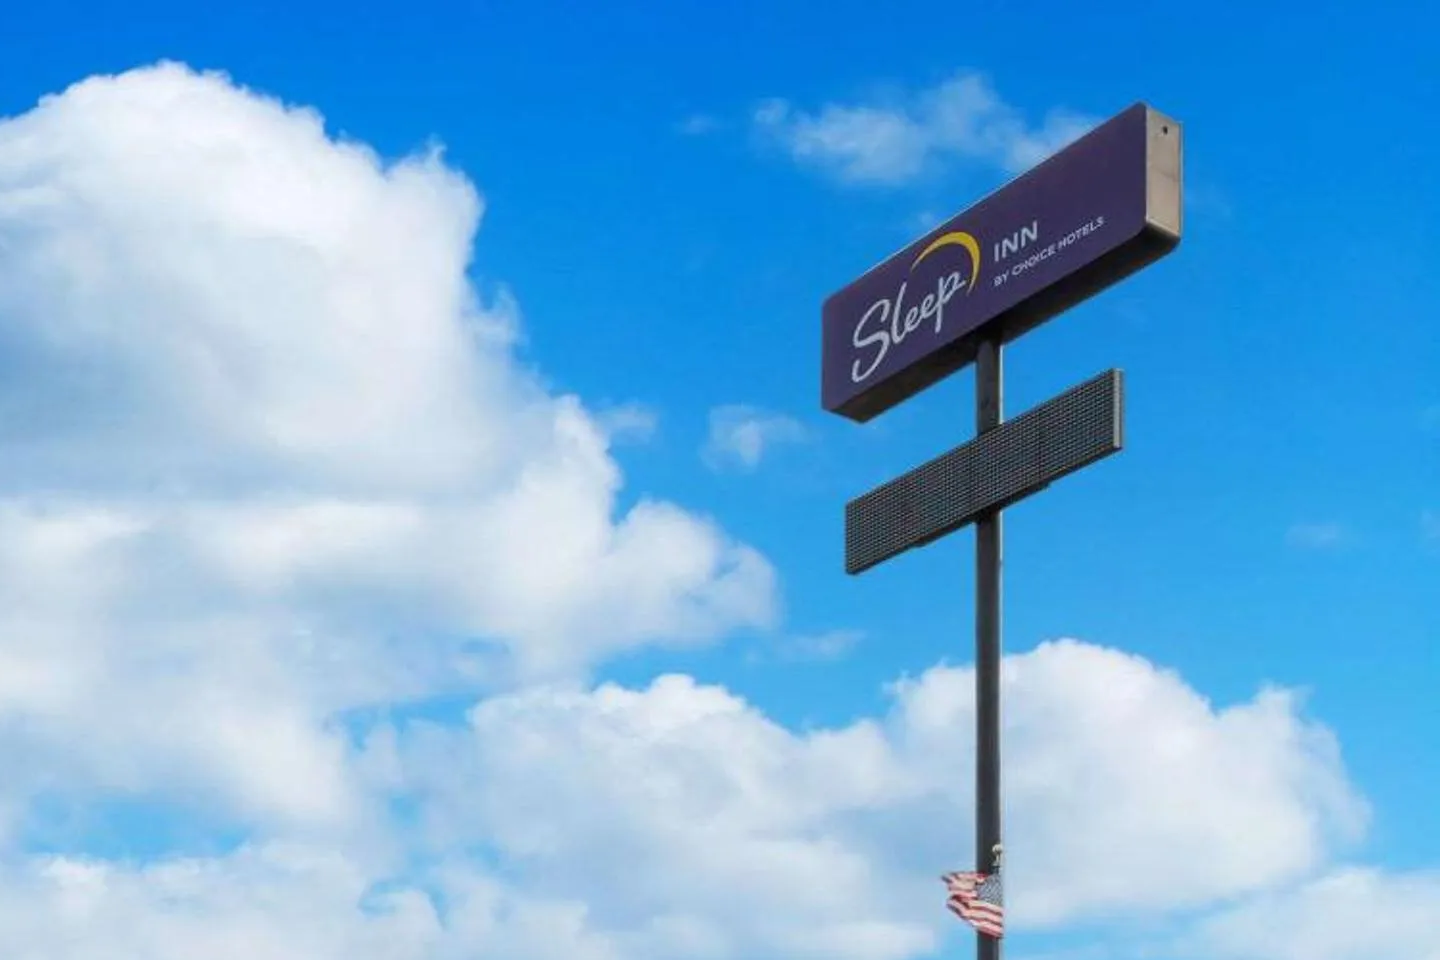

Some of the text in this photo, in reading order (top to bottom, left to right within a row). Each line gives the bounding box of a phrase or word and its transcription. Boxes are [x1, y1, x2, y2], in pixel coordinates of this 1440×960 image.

[851, 221, 1038, 383] Sleep INN
[993, 216, 1104, 287] BY CHOICE HOTELS
